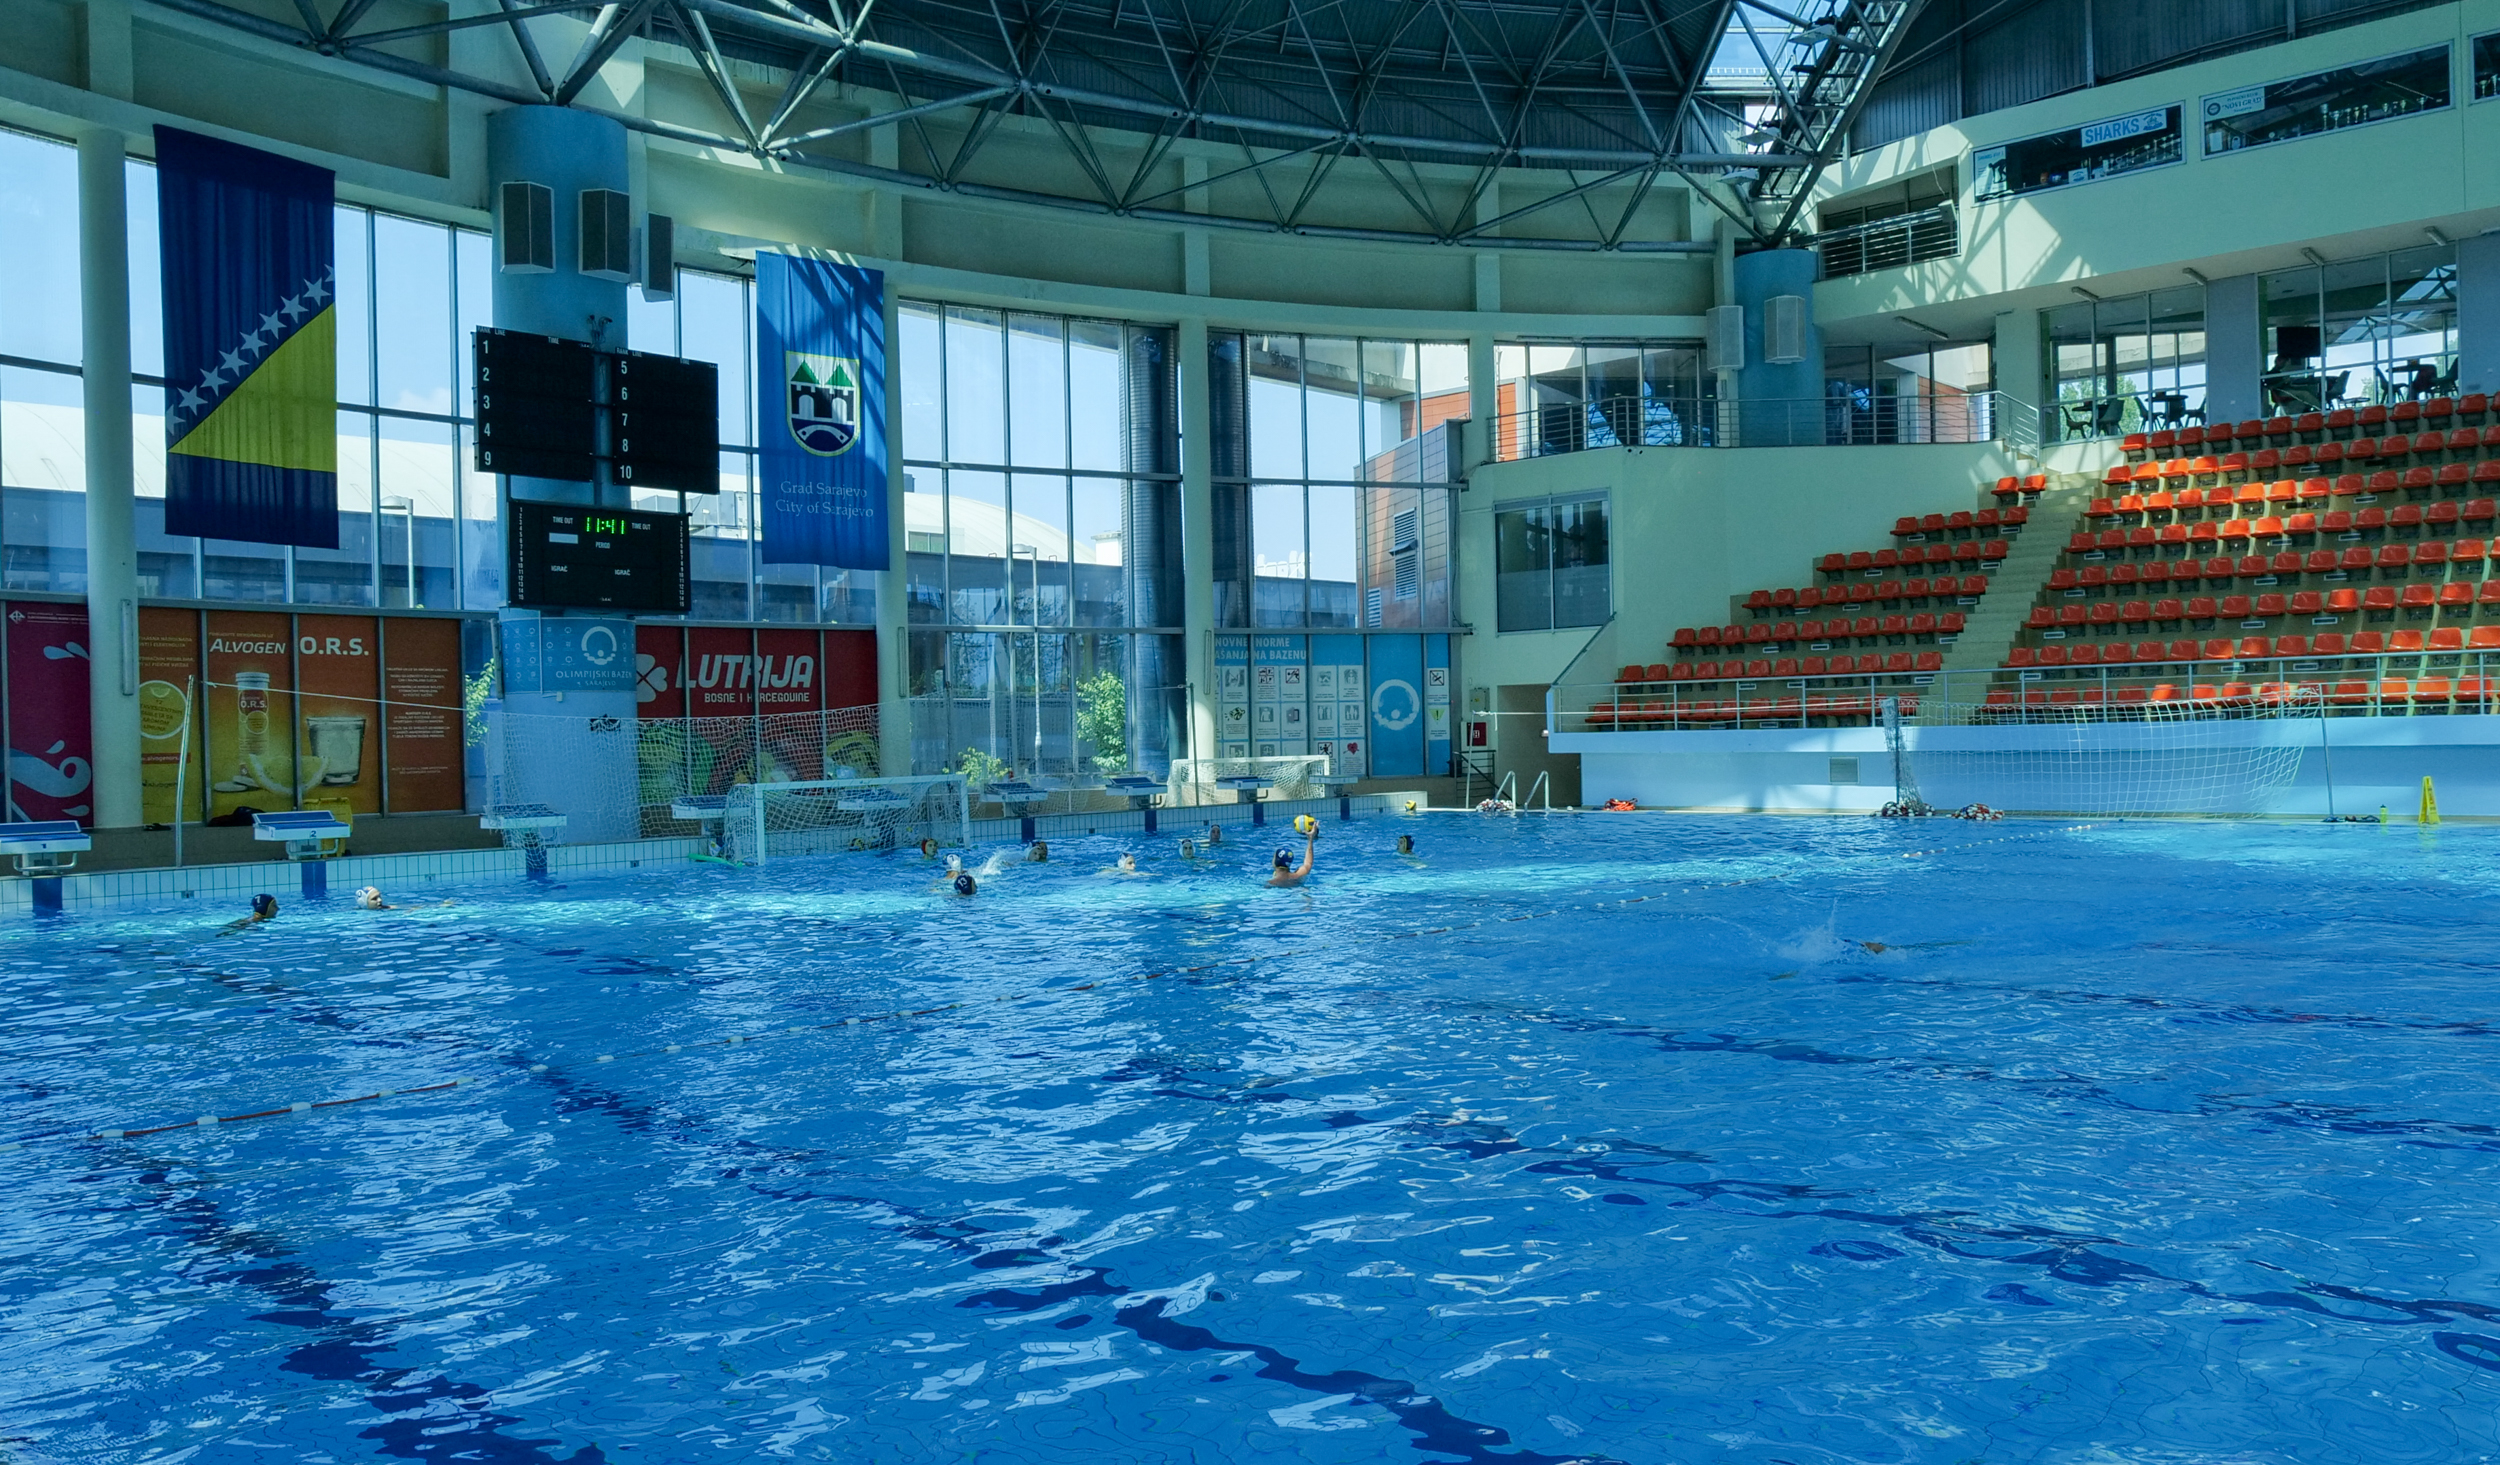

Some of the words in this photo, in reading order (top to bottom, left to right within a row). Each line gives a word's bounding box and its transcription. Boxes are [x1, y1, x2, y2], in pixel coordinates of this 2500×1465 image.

[2085, 118, 2140, 144] SHARKS
[483, 340, 489, 354] 1
[482, 367, 490, 381] 2
[621, 361, 628, 375] 5
[621, 387, 628, 400] 6
[483, 395, 490, 409] 3
[621, 413, 628, 426] 7
[483, 422, 491, 437] 4
[622, 438, 629, 452] 8
[484, 451, 491, 466] 9
[619, 465, 632, 479] 10
[780, 481, 813, 494] Grad
[816, 482, 868, 500] Sarajevo
[775, 499, 803, 517] City
[806, 501, 820, 514] of
[822, 501, 874, 520] Sarajevo
[552, 516, 563, 524] TIME
[586, 516, 625, 535] 11:41
[631, 522, 641, 530] TIME
[209, 638, 286, 654] ALVOGEN
[300, 636, 369, 656] O.R.S.
[1255, 637, 1290, 647] NORME
[1254, 649, 1267, 660] NA
[1269, 649, 1307, 660] BAZENU
[555, 670, 610, 679] OLIMPIJSKI
[675, 654, 814, 688] LUTRIJA
[240, 700, 267, 708] O.R.S.
[704, 692, 736, 703] BOSNE
[740, 693, 743, 703] I
[747, 692, 810, 703] HRCEGOVINE
[310, 830, 317, 838] 2
[1278, 849, 1286, 858] 8
[957, 877, 968, 887] 13
